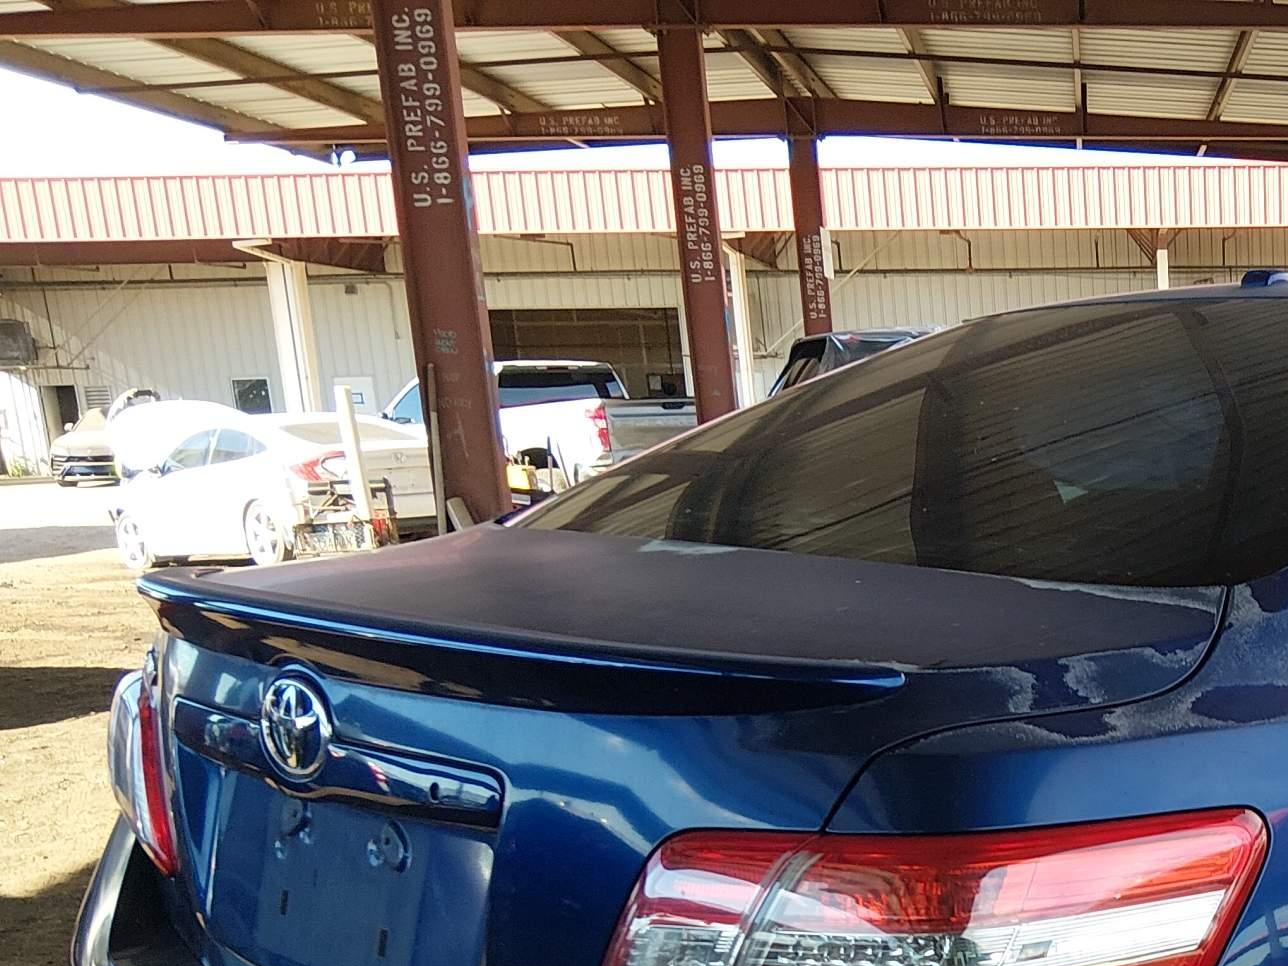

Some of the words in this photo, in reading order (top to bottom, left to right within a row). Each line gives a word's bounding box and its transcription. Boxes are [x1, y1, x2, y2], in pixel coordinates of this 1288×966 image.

[391, 7, 413, 50] INC.
[397, 63, 425, 152] PREFAB
[414, 8, 455, 204] 1-866-799-0969
[411, 164, 432, 208] U.S.
[683, 196, 699, 250] PREFAB
[692, 164, 716, 281] 1-866-799-0969
[689, 257, 703, 283] U.S.
[804, 257, 816, 295] PREFAB
